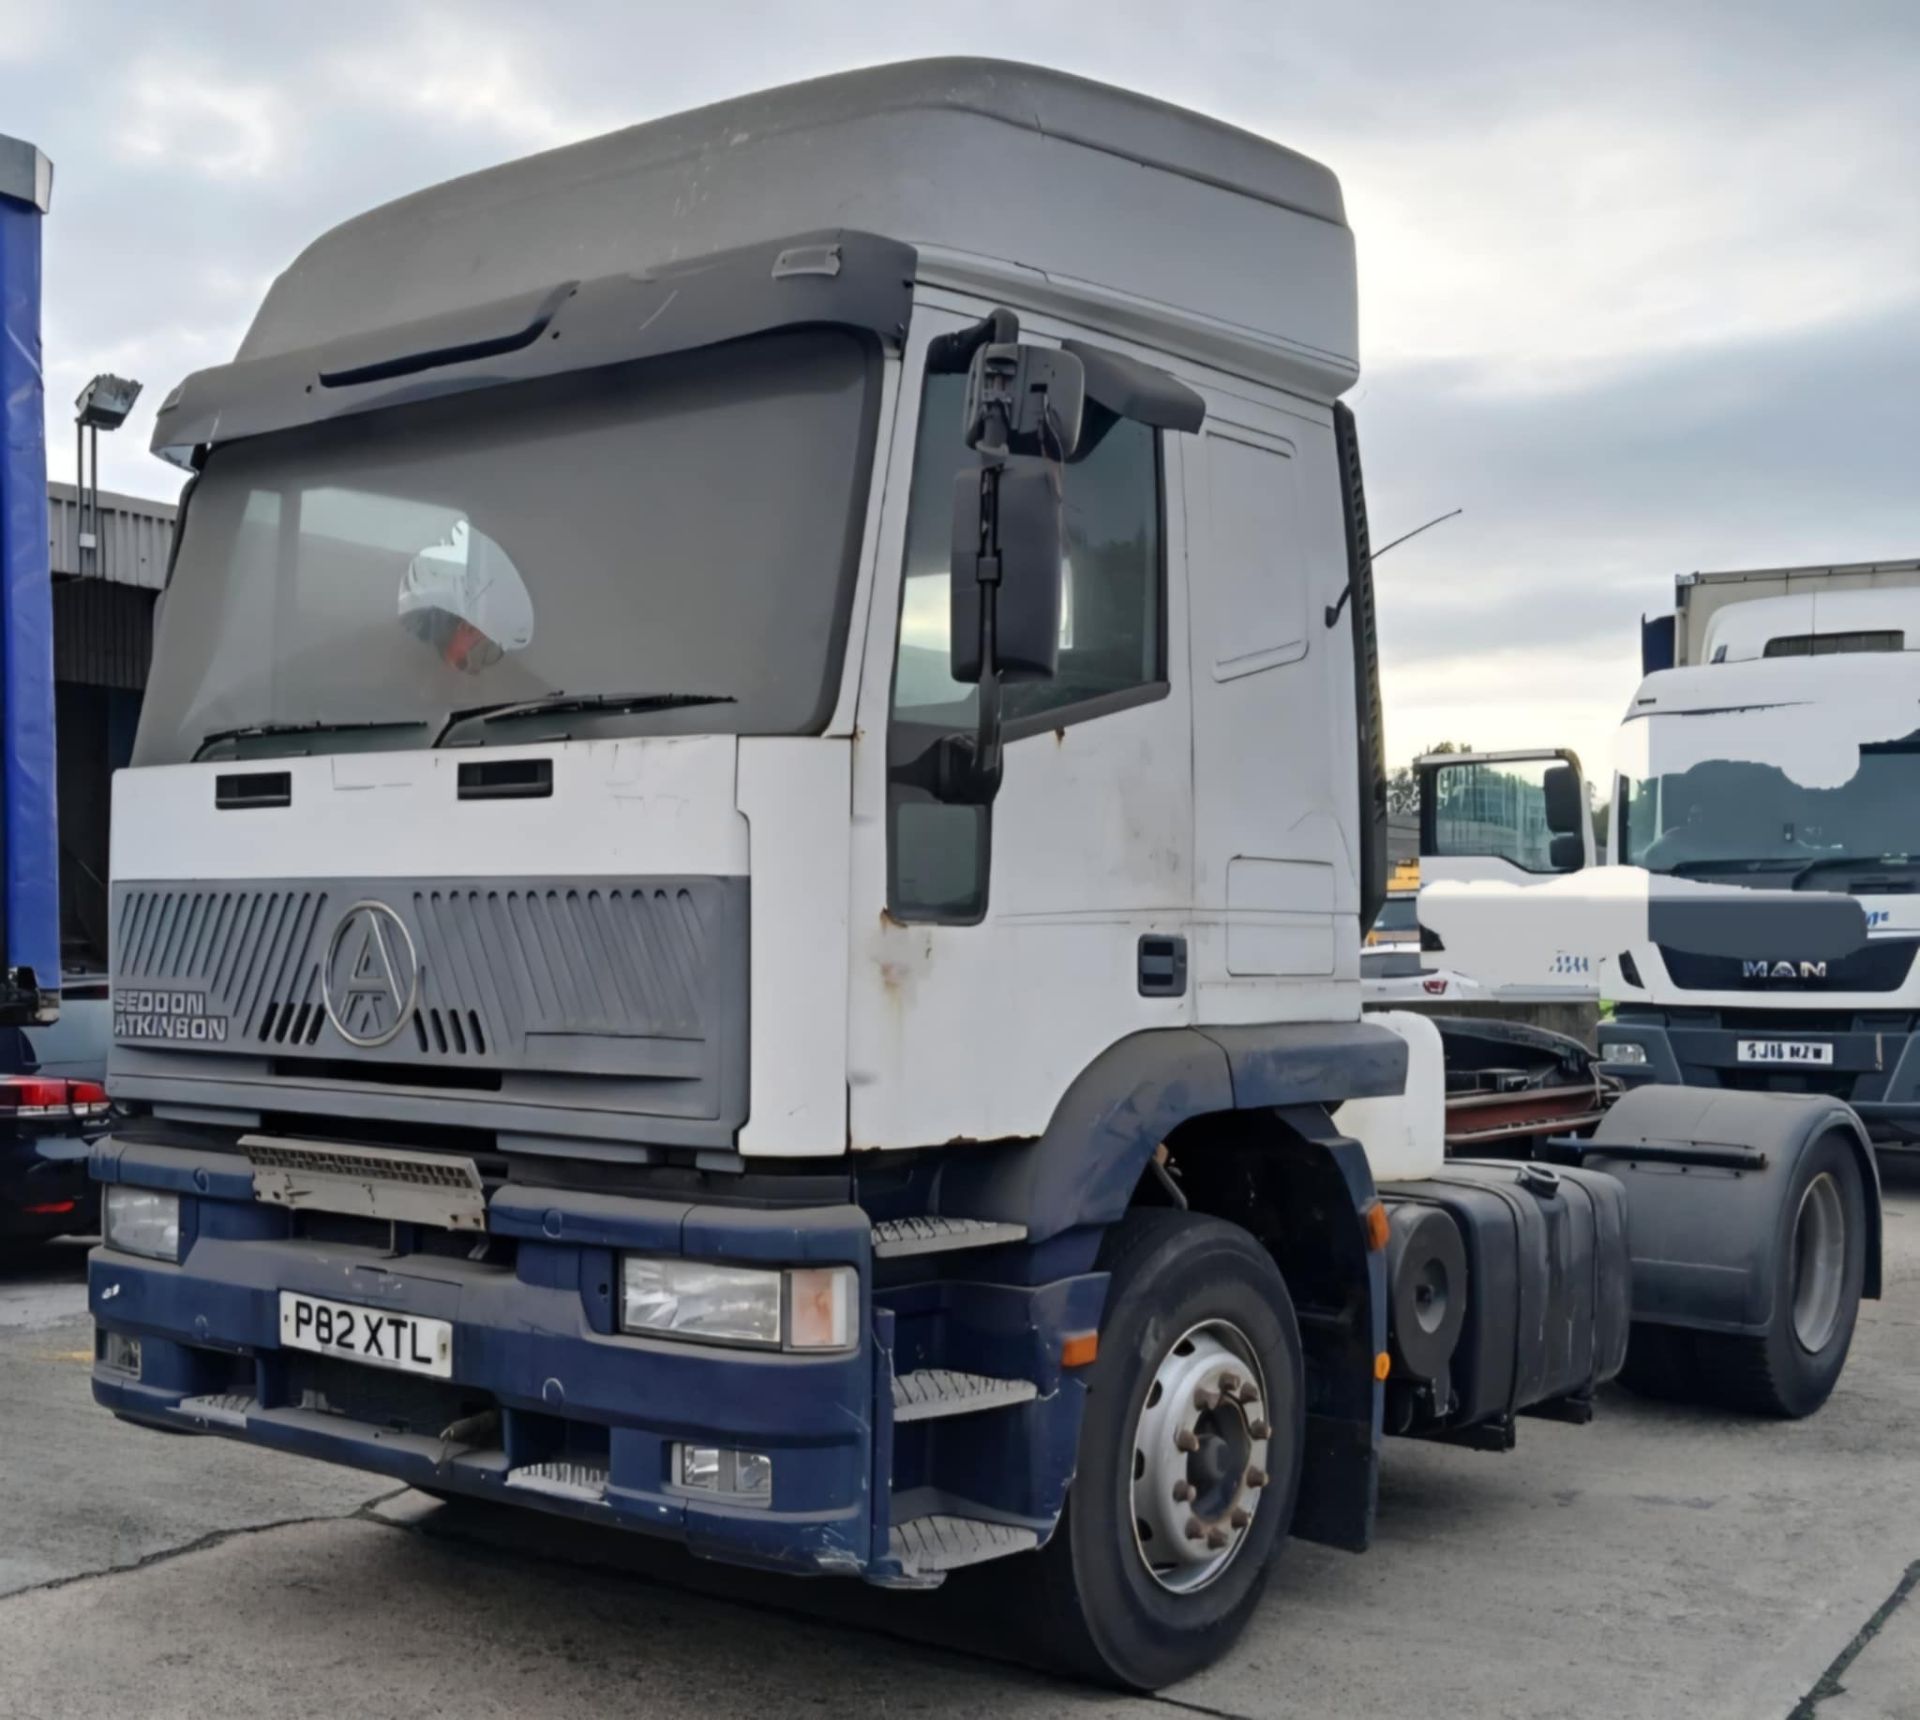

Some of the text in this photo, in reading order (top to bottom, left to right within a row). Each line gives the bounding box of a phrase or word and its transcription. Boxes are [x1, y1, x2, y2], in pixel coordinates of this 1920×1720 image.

[1742, 960, 1827, 977] MAN
[114, 988, 204, 1015] SEDDON
[114, 1013, 226, 1041] ATKINSON
[363, 1314, 433, 1365] XTL
